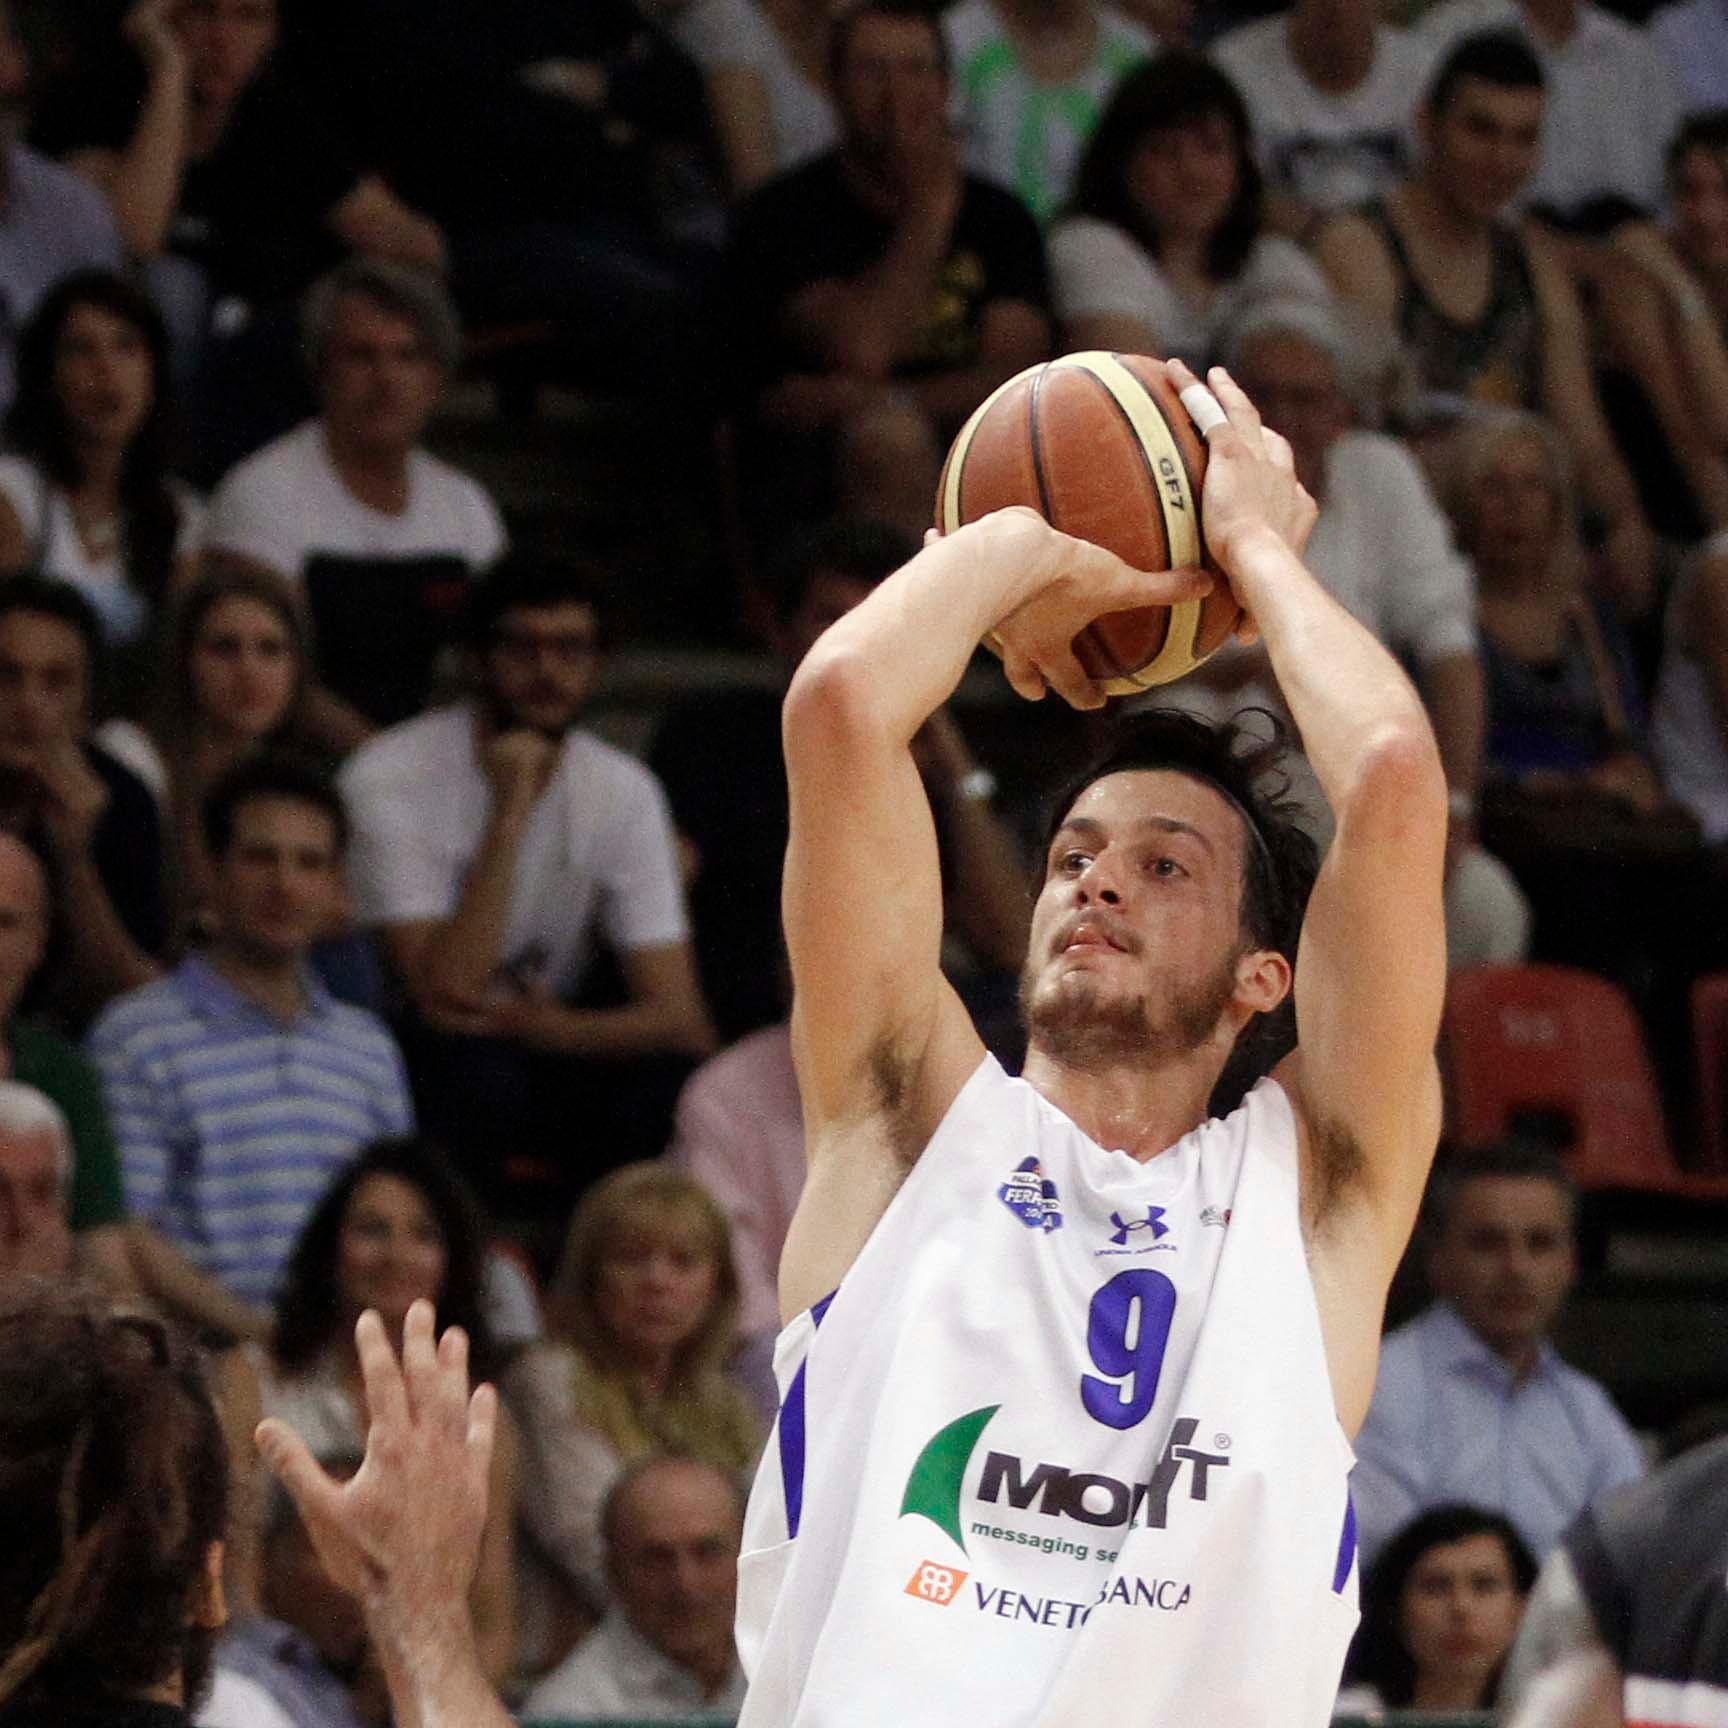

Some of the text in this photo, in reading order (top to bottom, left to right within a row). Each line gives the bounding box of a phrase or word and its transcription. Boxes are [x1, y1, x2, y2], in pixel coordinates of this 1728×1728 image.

[1159, 457, 1185, 512] GF7
[1080, 1268, 1177, 1430] 9
[971, 1521, 1088, 1563] messaging
